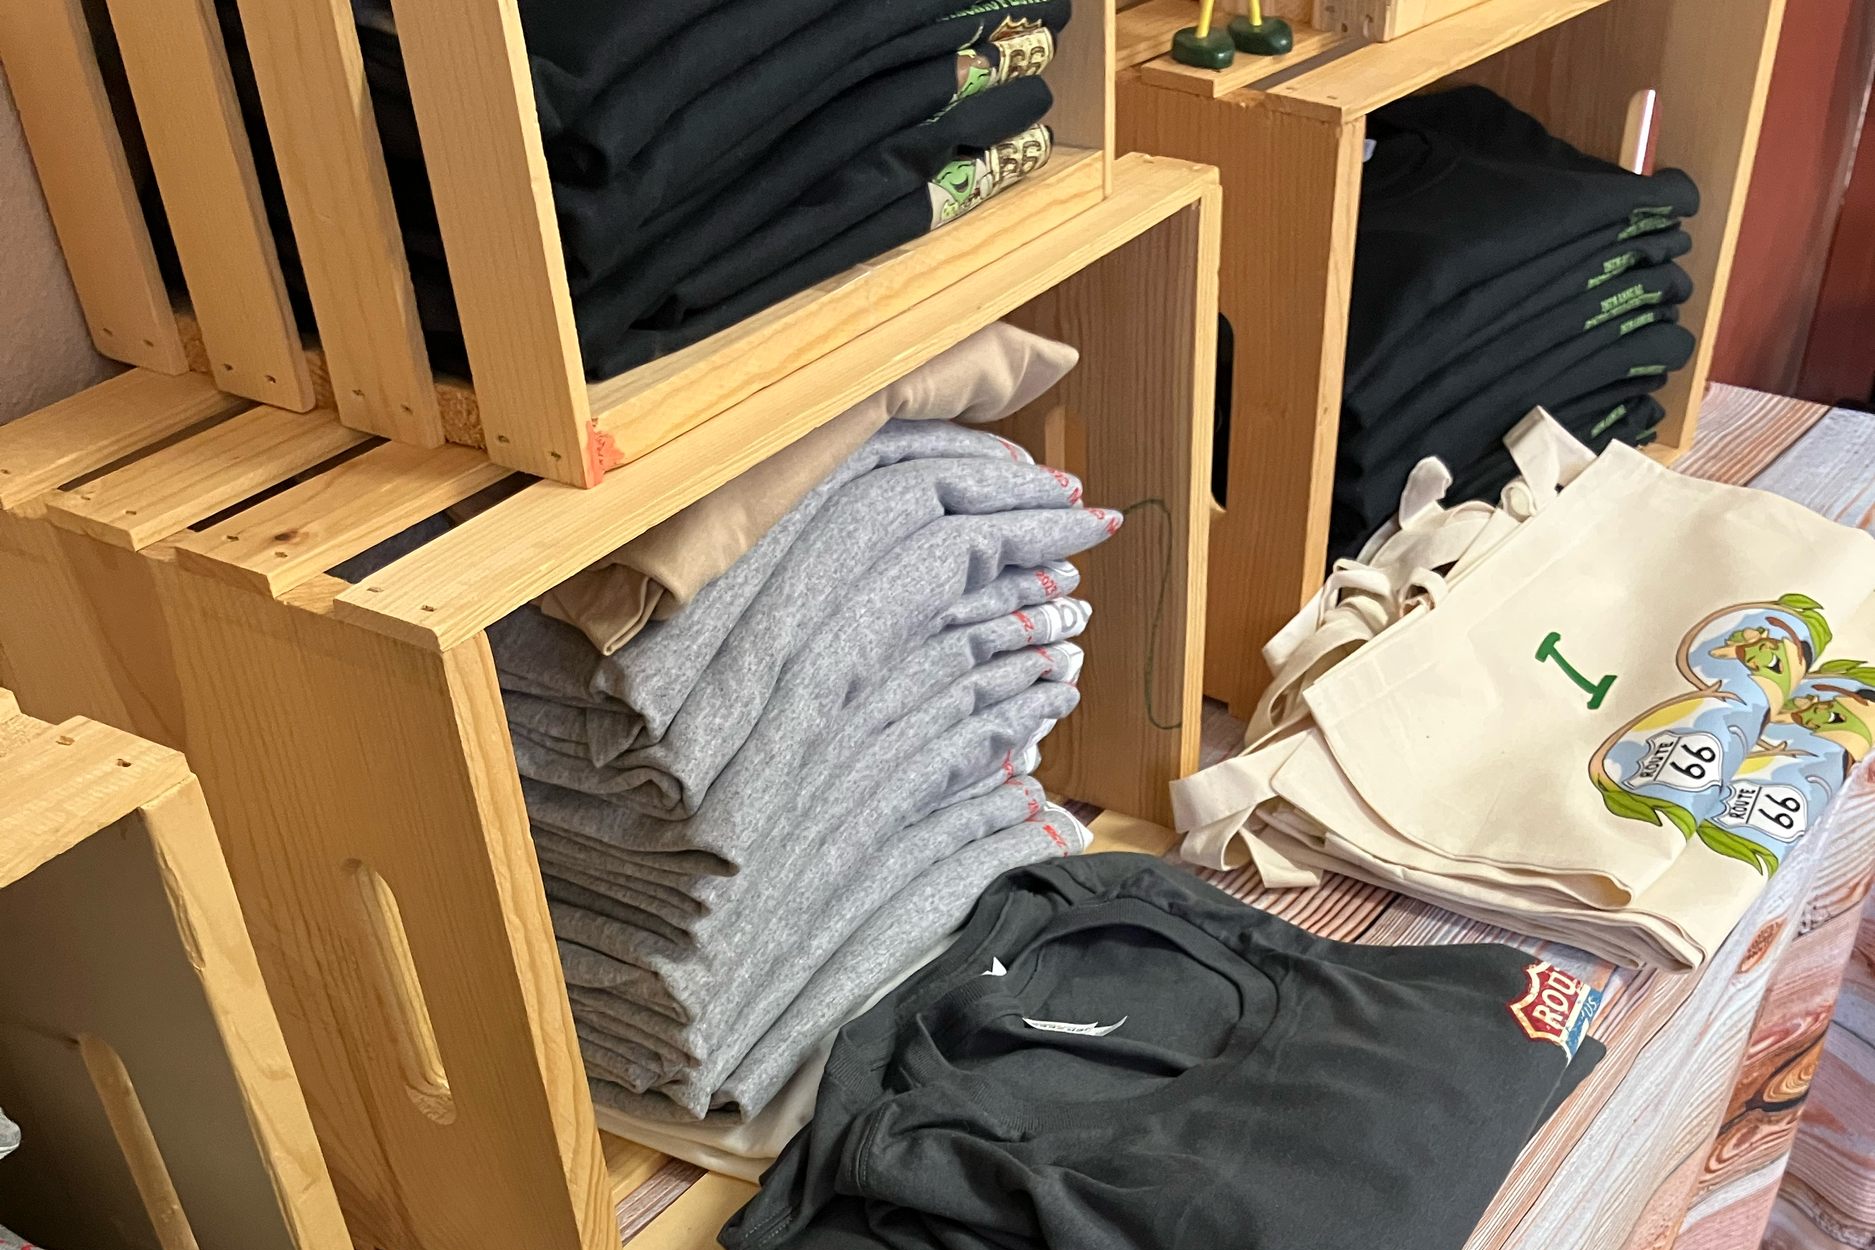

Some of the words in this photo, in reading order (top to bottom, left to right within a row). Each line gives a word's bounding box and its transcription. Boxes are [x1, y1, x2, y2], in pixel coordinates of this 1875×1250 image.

[1534, 631, 1618, 710] I
[1639, 740, 1675, 779] ROUTE
[1669, 743, 1716, 780] 66
[1728, 788, 1757, 820] ROUTE
[1757, 793, 1801, 830] 66
[1531, 969, 1577, 1031] ROU
